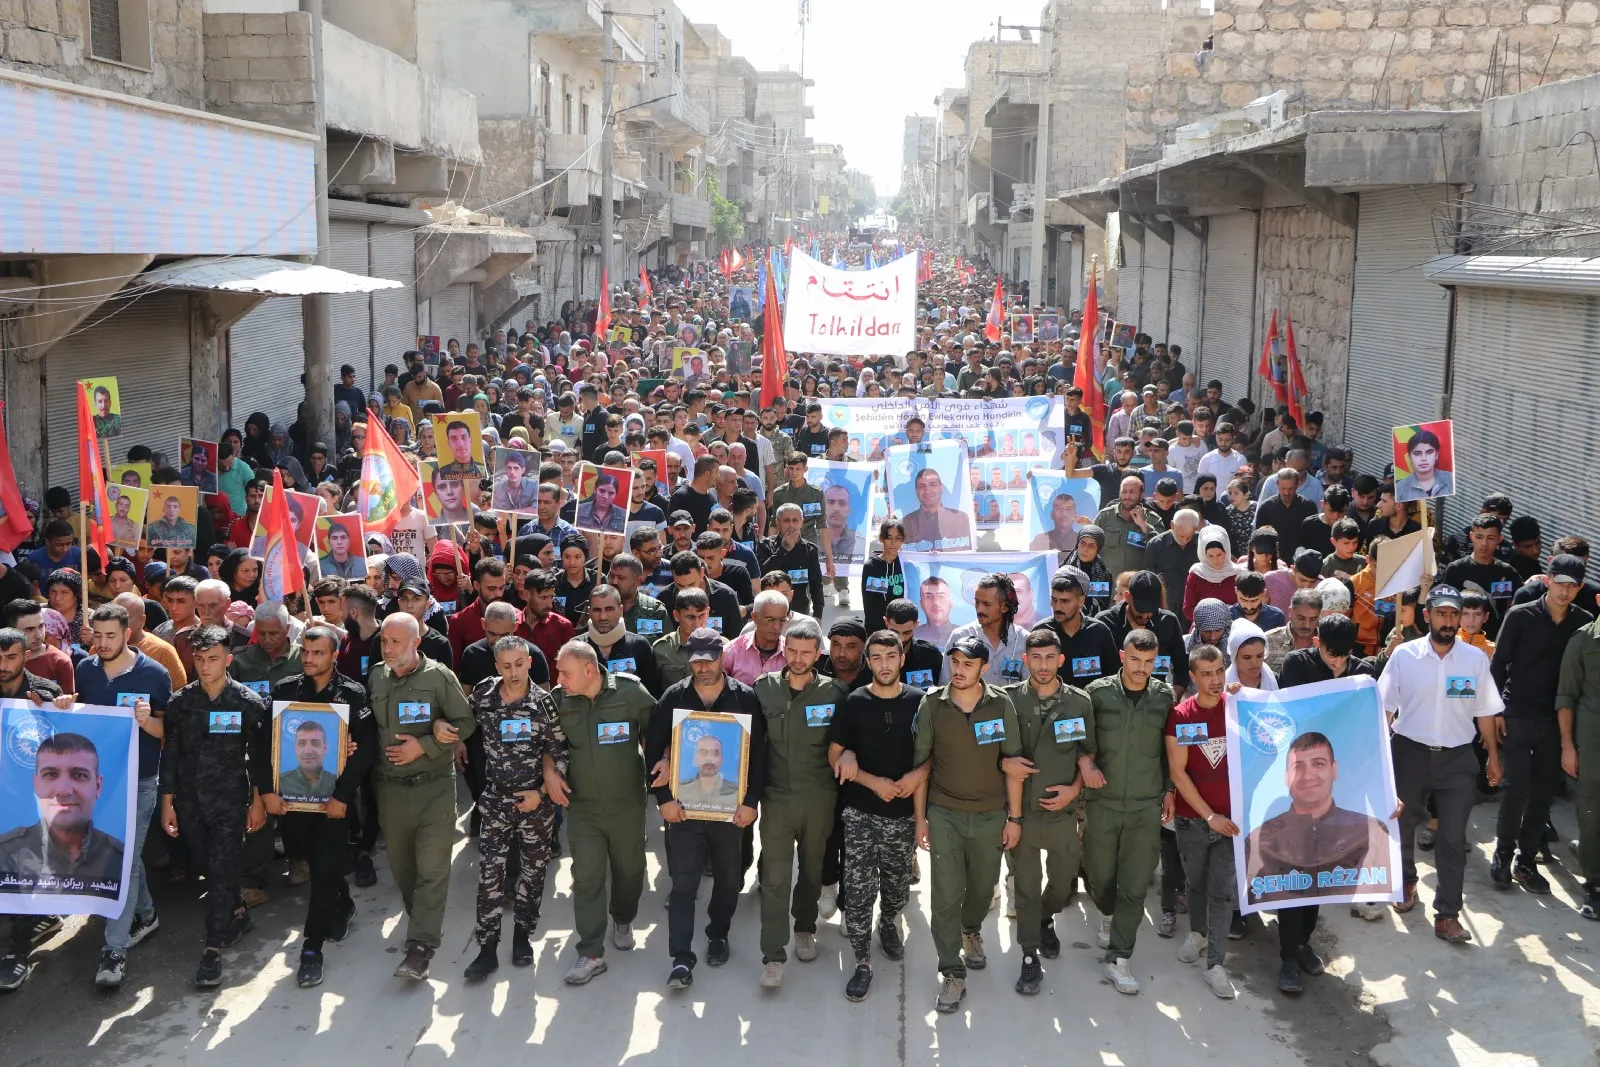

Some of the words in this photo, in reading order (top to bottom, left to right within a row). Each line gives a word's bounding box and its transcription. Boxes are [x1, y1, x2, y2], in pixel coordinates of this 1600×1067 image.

[808, 313, 901, 336] Tolhildan
[929, 412, 980, 423] Ewlekariya
[1251, 868, 1313, 899] ŞEHÎD
[1317, 865, 1388, 888] RÊZAN
